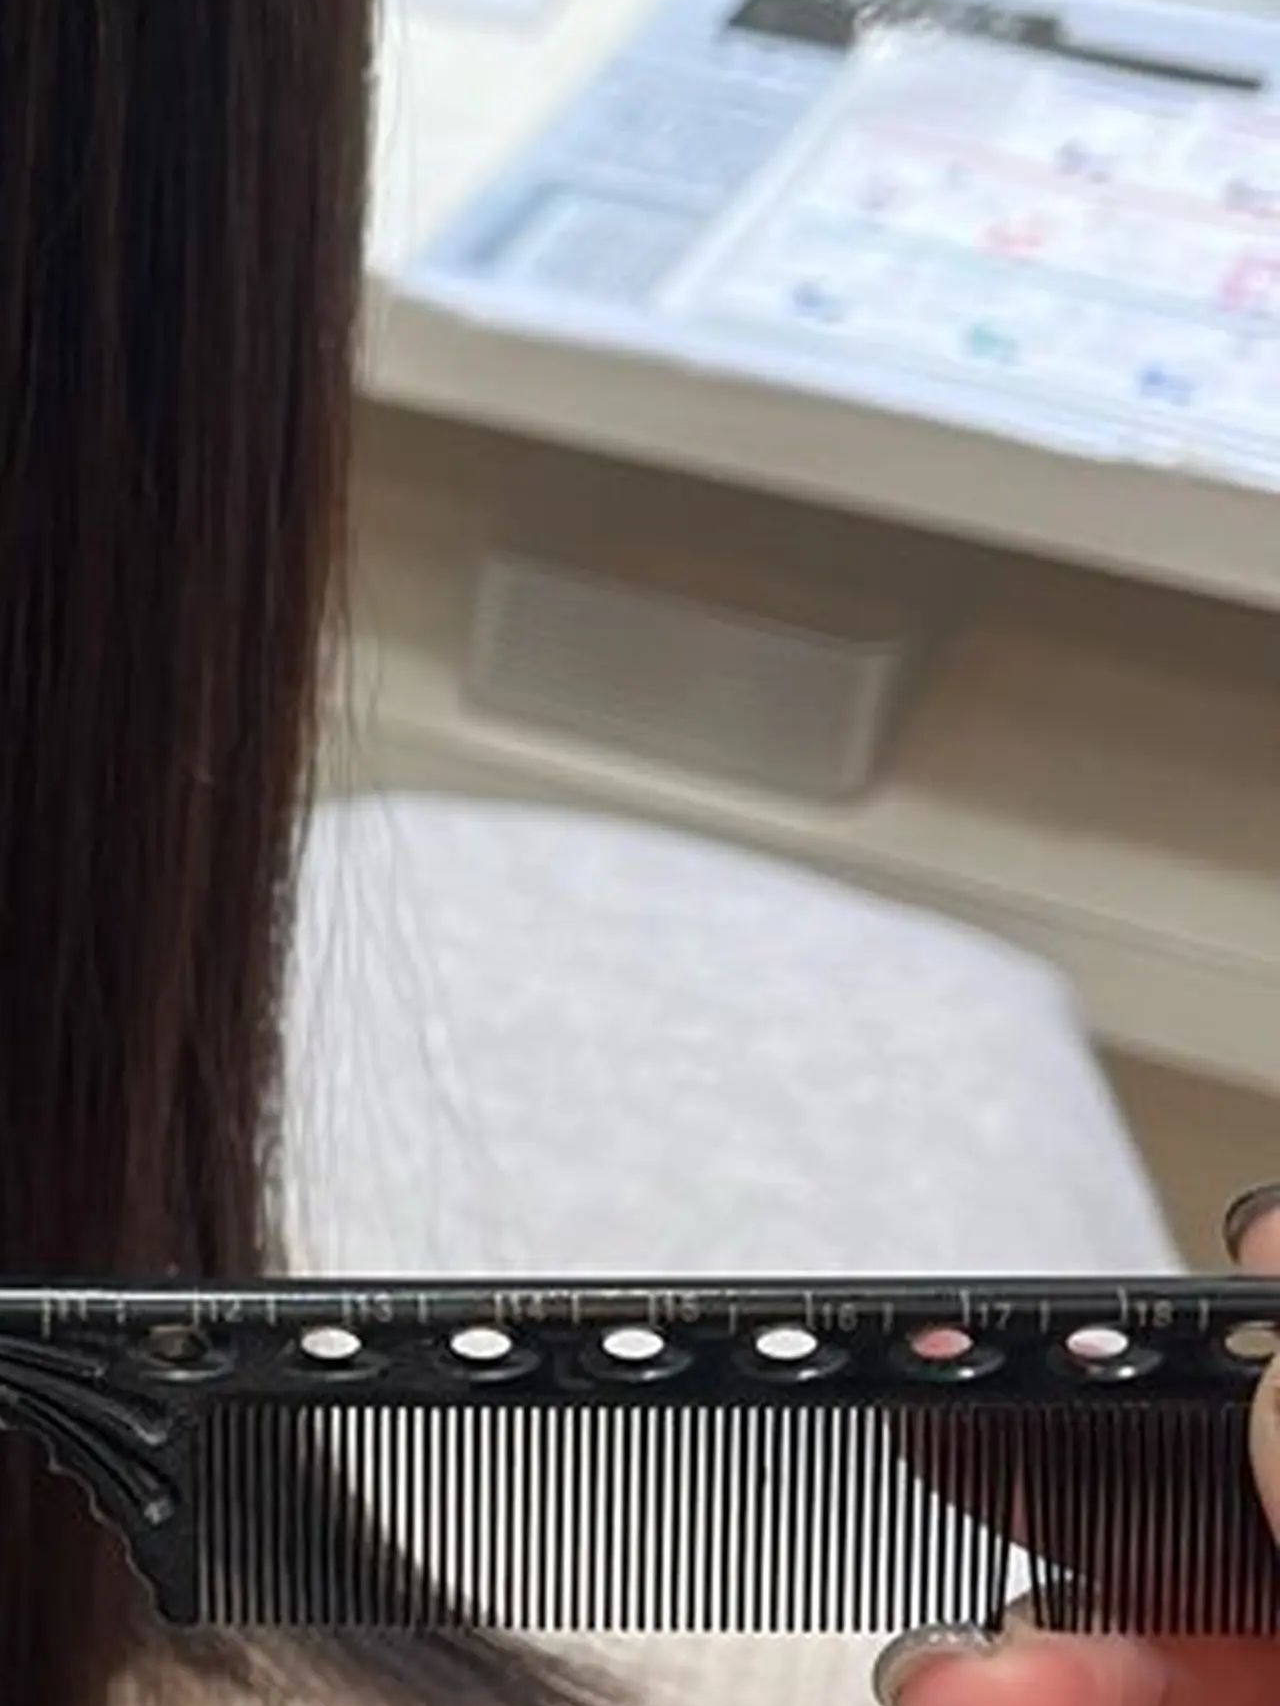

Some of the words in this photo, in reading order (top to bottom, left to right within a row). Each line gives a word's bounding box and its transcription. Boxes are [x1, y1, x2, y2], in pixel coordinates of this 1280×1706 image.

[209, 1293, 242, 1323] 12
[356, 1291, 391, 1322] 13
[661, 1290, 698, 1323] 15
[822, 1301, 858, 1332] 16
[979, 1301, 1011, 1330] 17
[1136, 1298, 1174, 1328] 18
